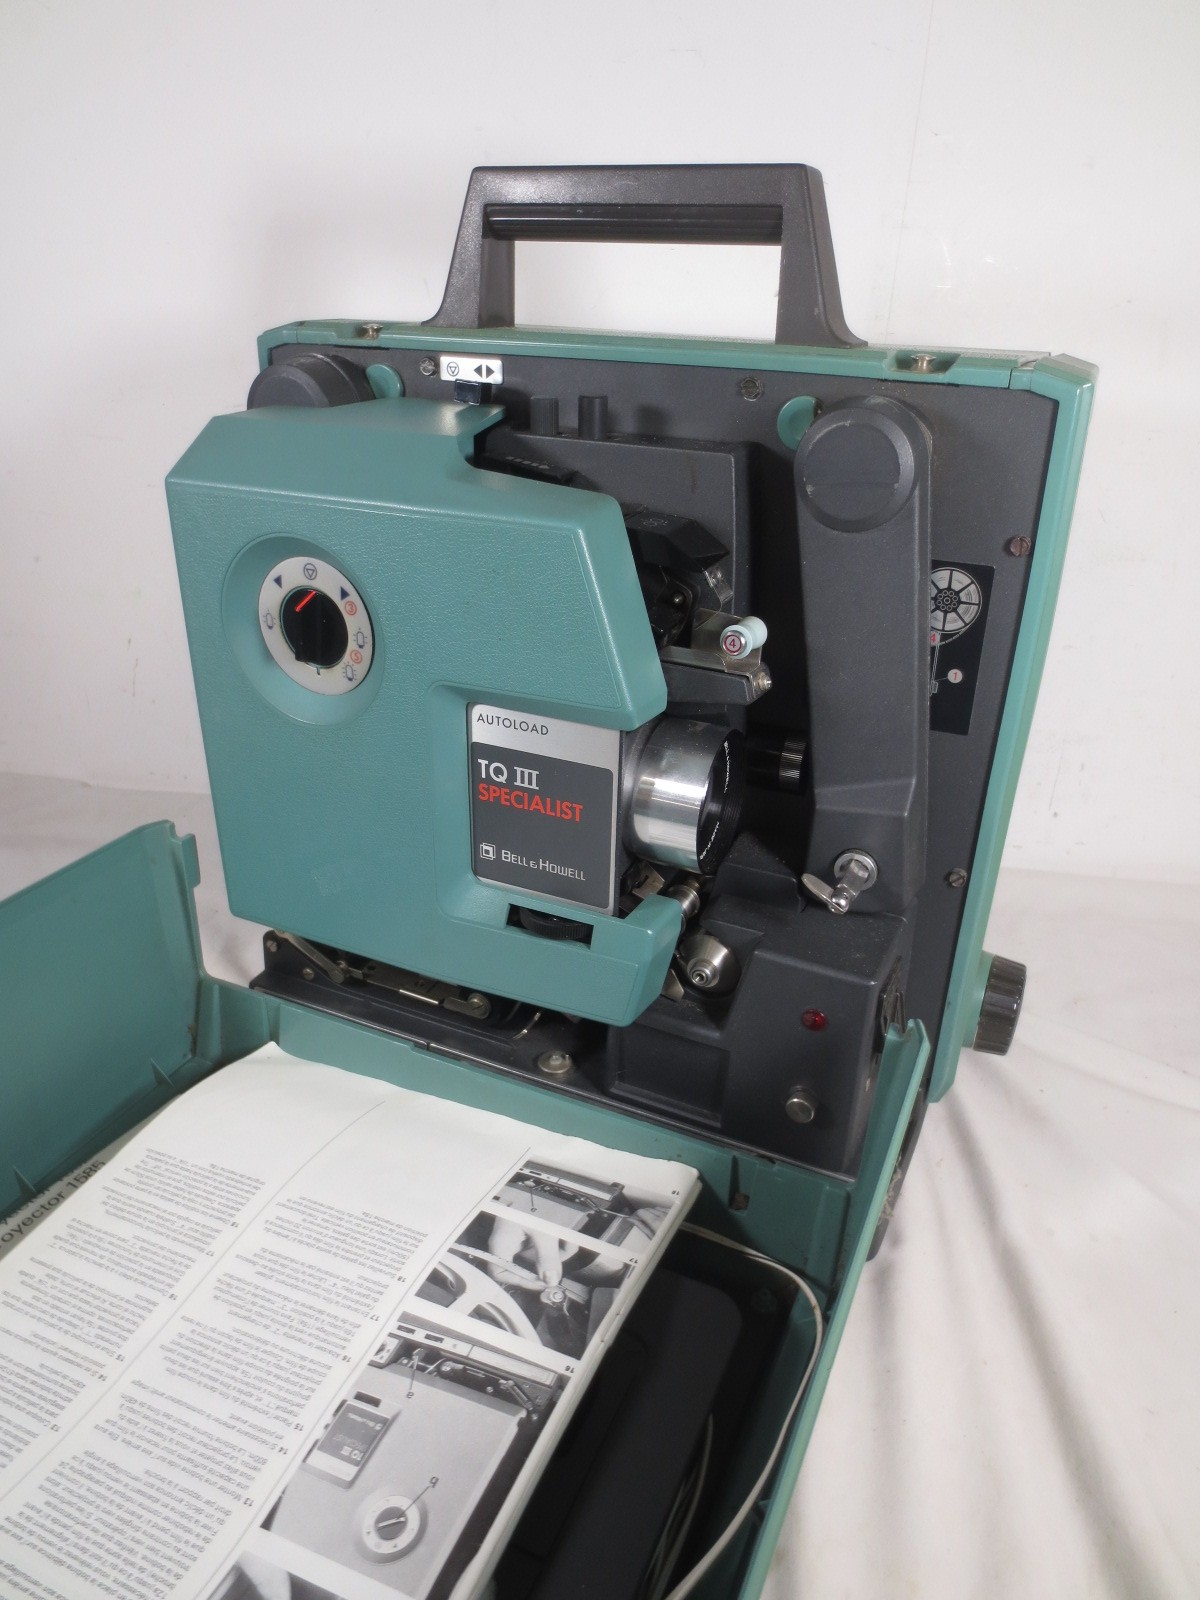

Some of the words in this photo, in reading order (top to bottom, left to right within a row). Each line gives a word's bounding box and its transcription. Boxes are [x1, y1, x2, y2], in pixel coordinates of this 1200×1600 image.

[476, 712, 549, 736] AUTOLOAD
[477, 758, 508, 784] TQ
[513, 766, 540, 790] III
[478, 782, 584, 822] SPECIALIST
[406, 1390, 415, 1400] a
[430, 1475, 440, 1488] b
